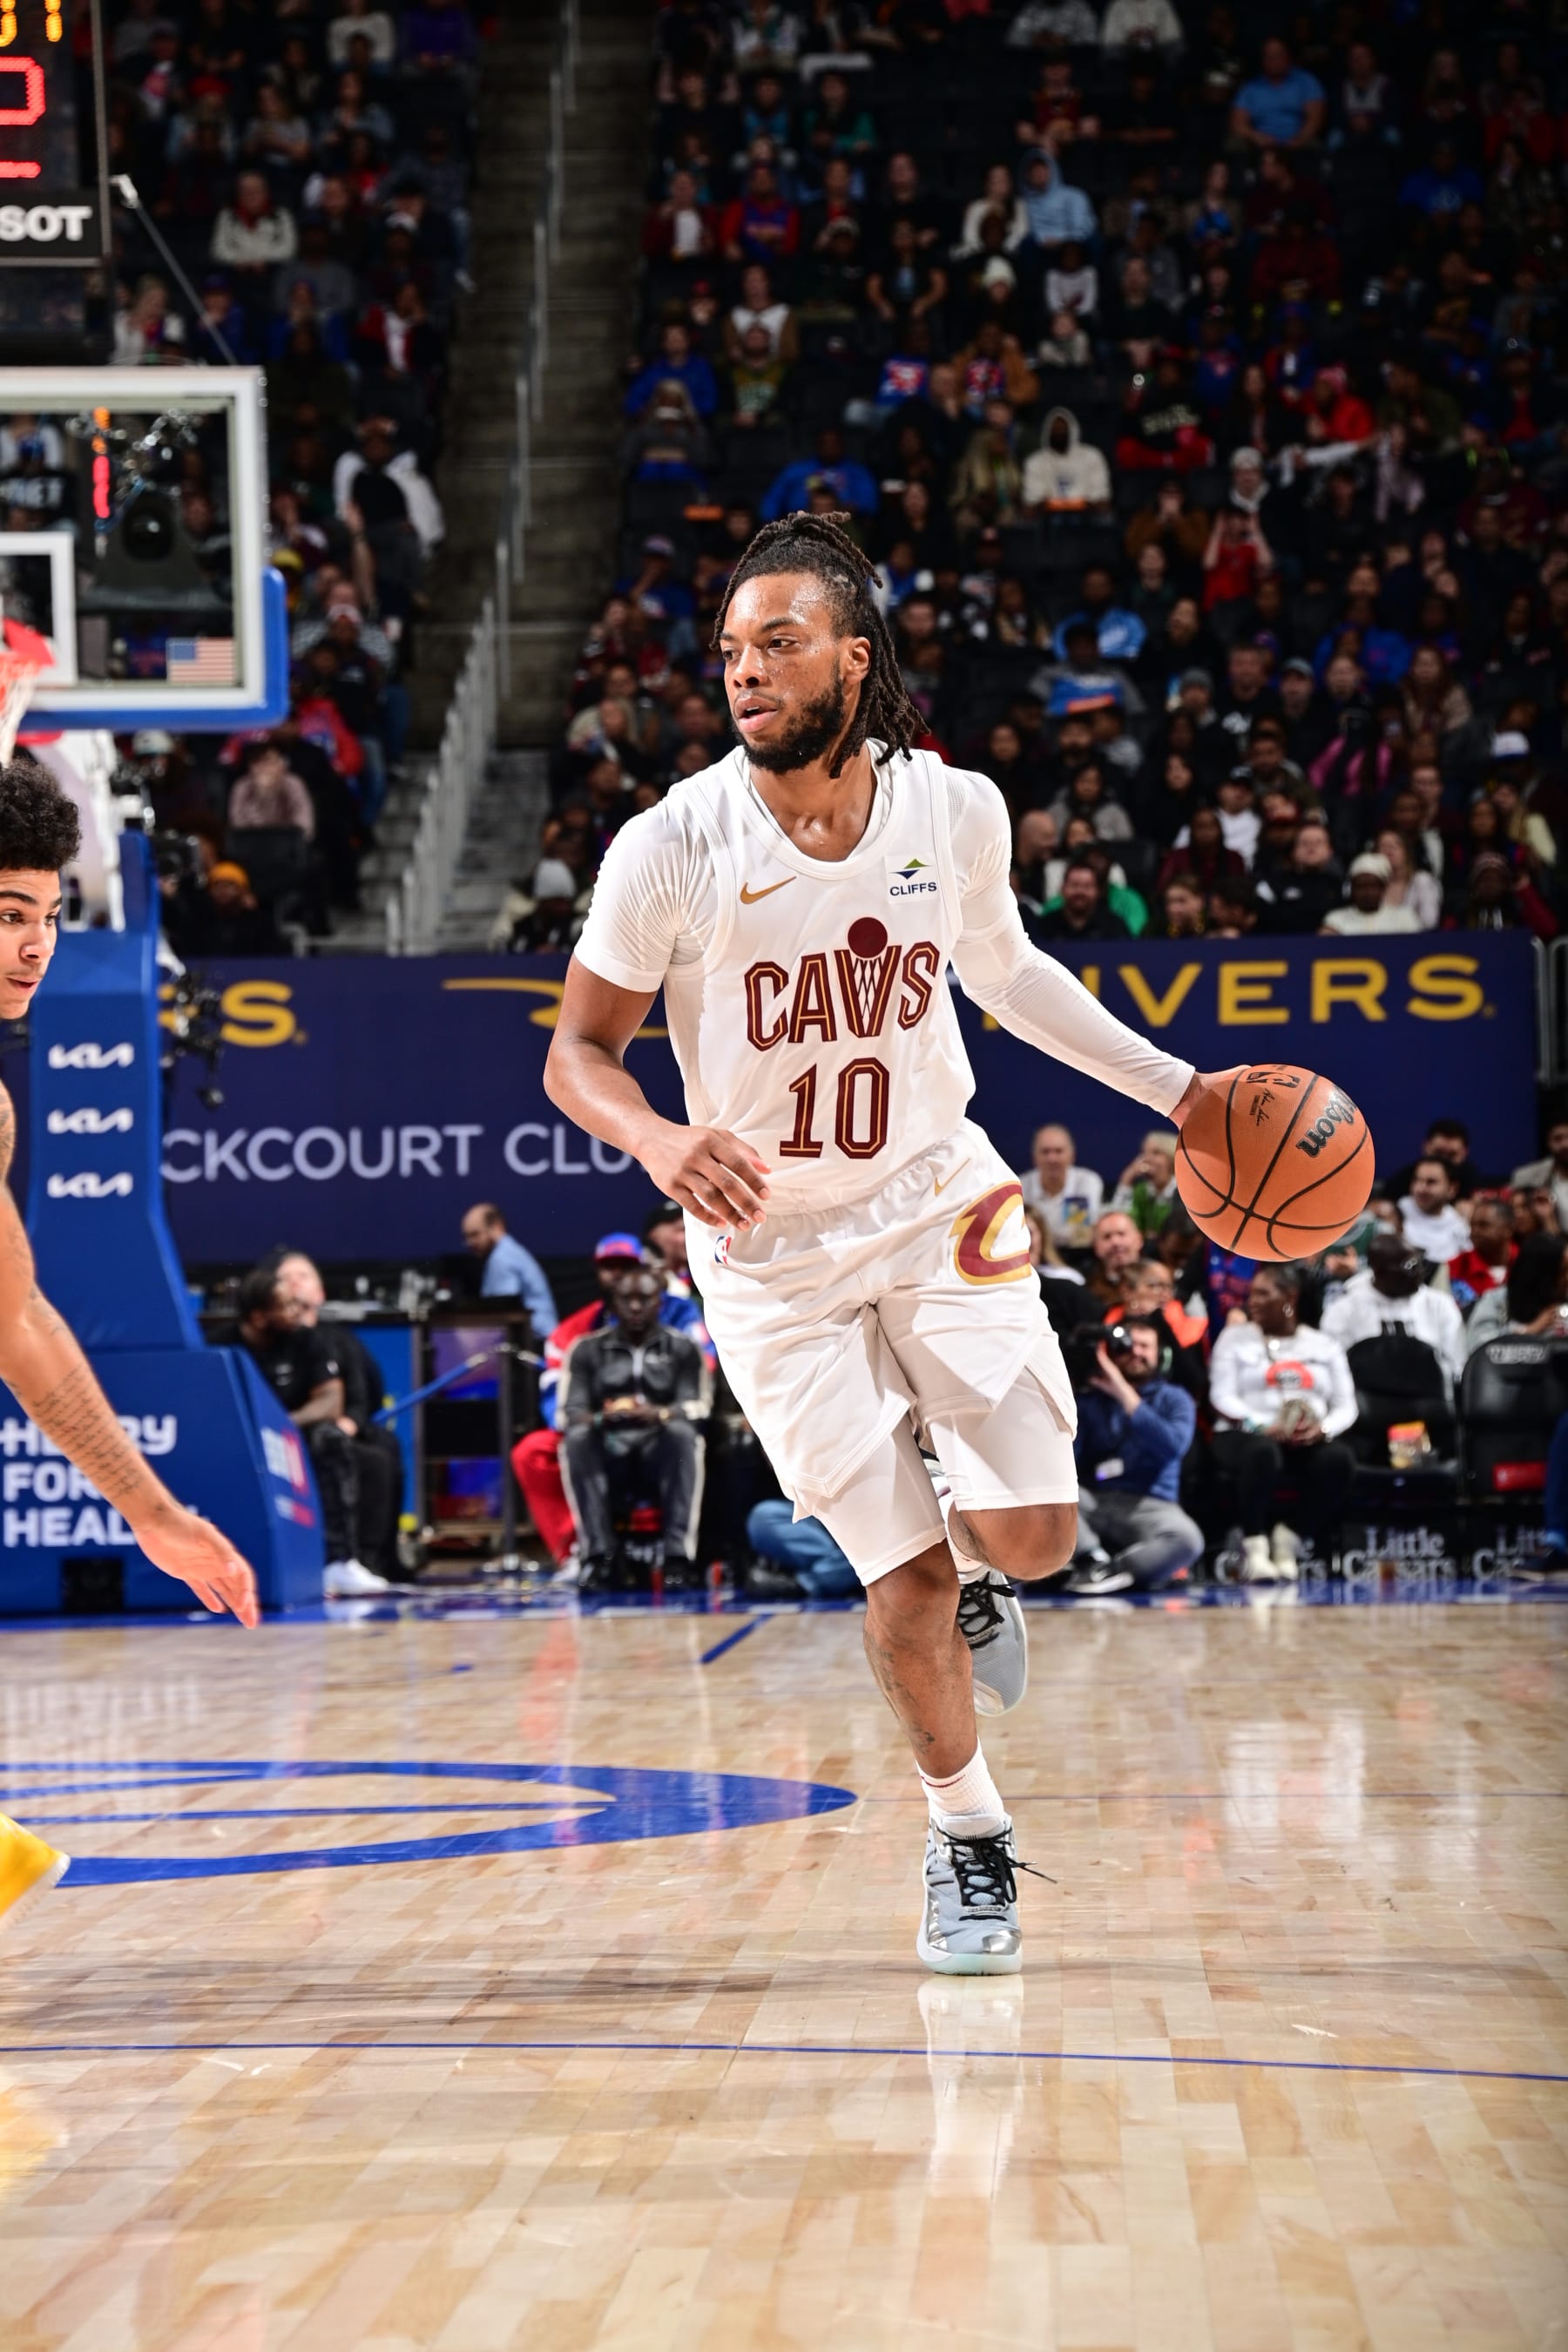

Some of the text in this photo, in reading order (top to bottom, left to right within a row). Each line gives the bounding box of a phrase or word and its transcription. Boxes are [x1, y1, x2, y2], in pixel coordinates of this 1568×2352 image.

[889, 882, 937, 896] CLIFFS
[744, 941, 941, 1052] CAVS
[779, 1057, 890, 1159] 10
[504, 1123, 645, 1176] CLU
[3, 1505, 199, 1548] HEAL
[1366, 1526, 1444, 1558] Little
[1342, 1550, 1456, 1582] Casars
